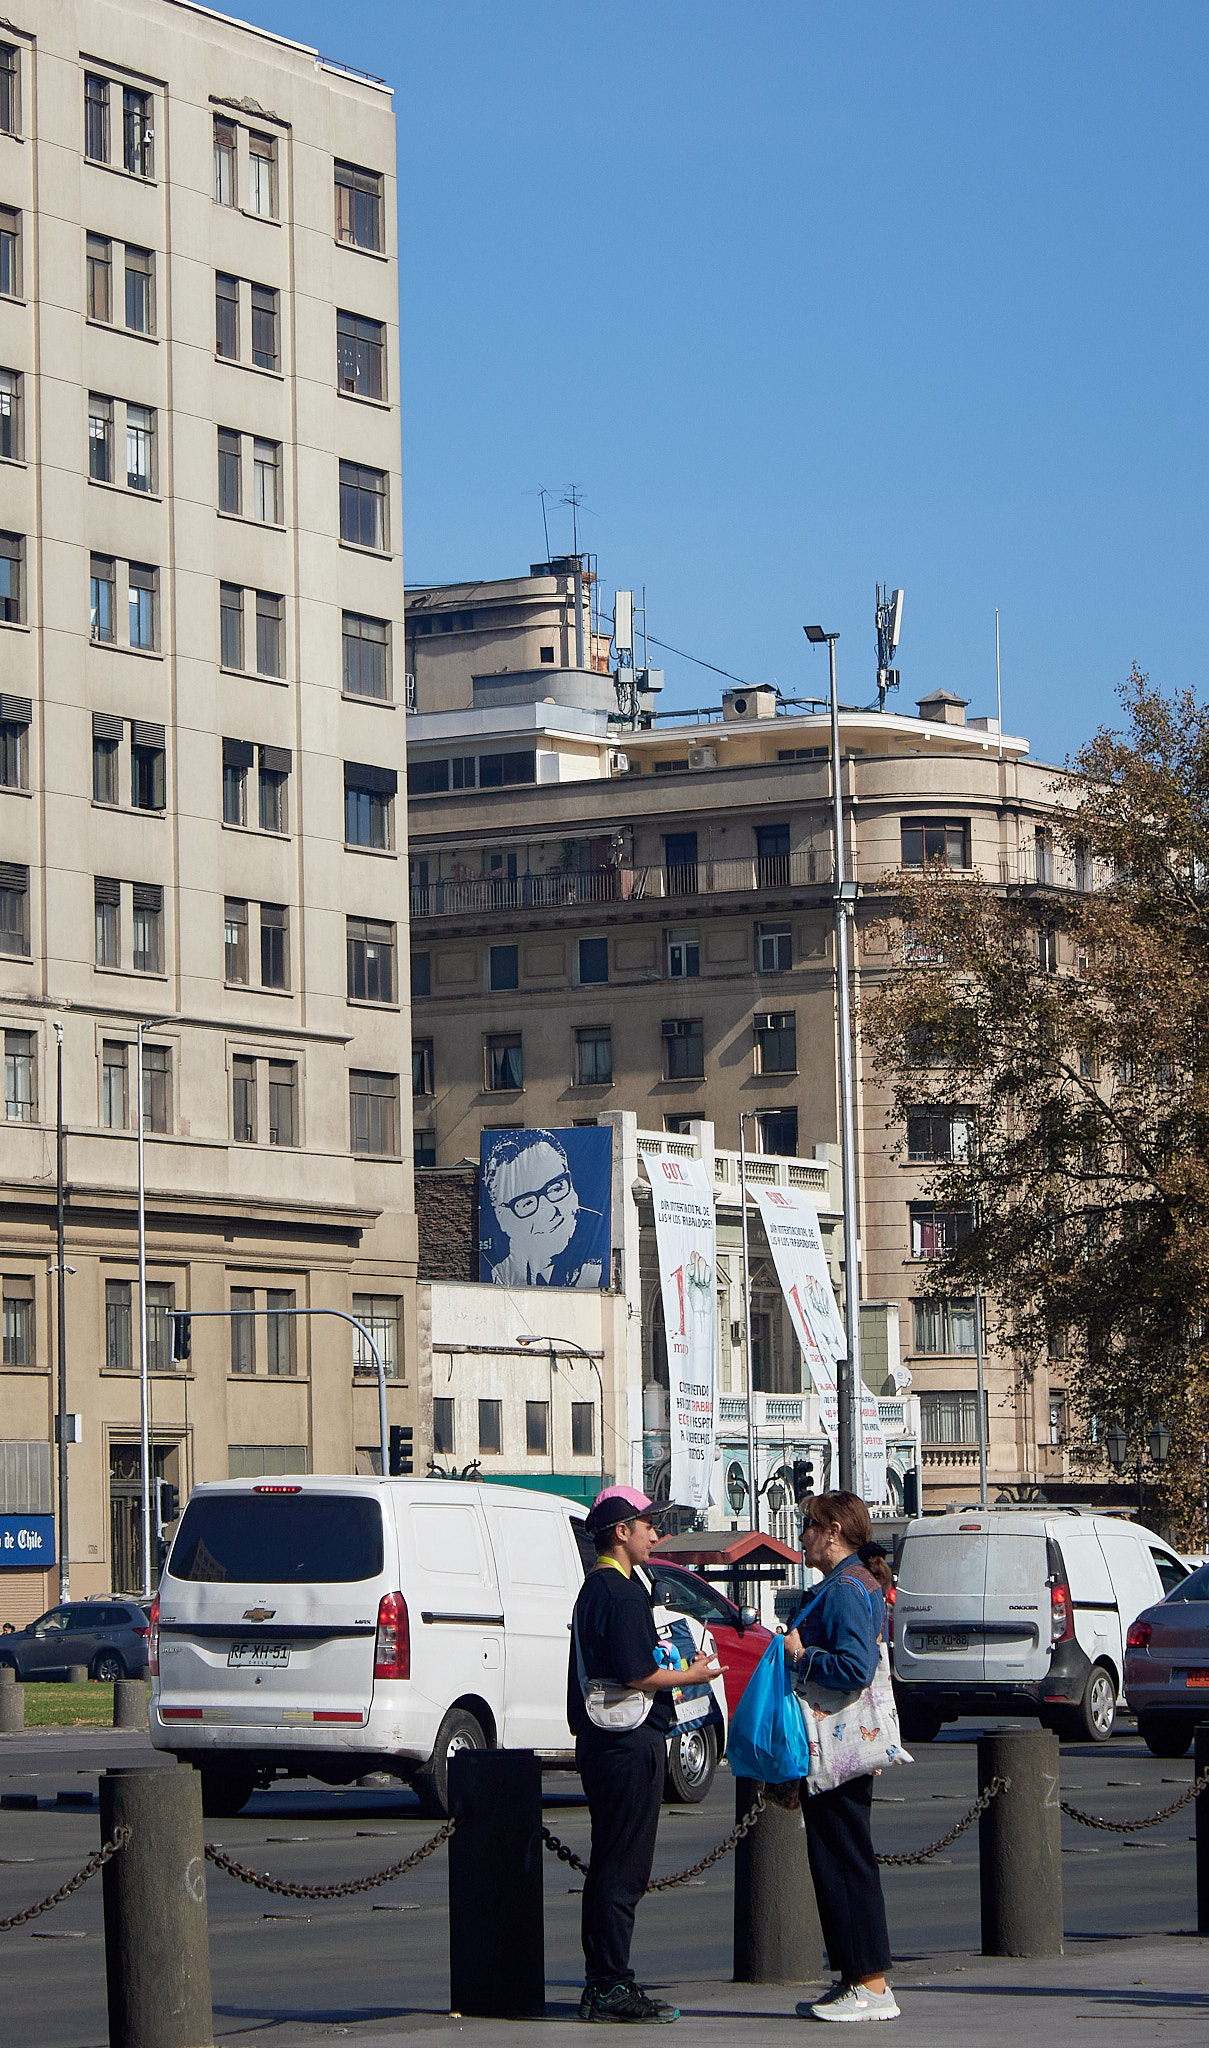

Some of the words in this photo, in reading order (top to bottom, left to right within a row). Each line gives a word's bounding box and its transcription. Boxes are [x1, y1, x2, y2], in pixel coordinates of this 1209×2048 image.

[661, 1162, 684, 1181] CUT
[765, 1191, 789, 1205] CUT
[4, 1531, 15, 1549] de
[17, 1529, 43, 1551] Chile
